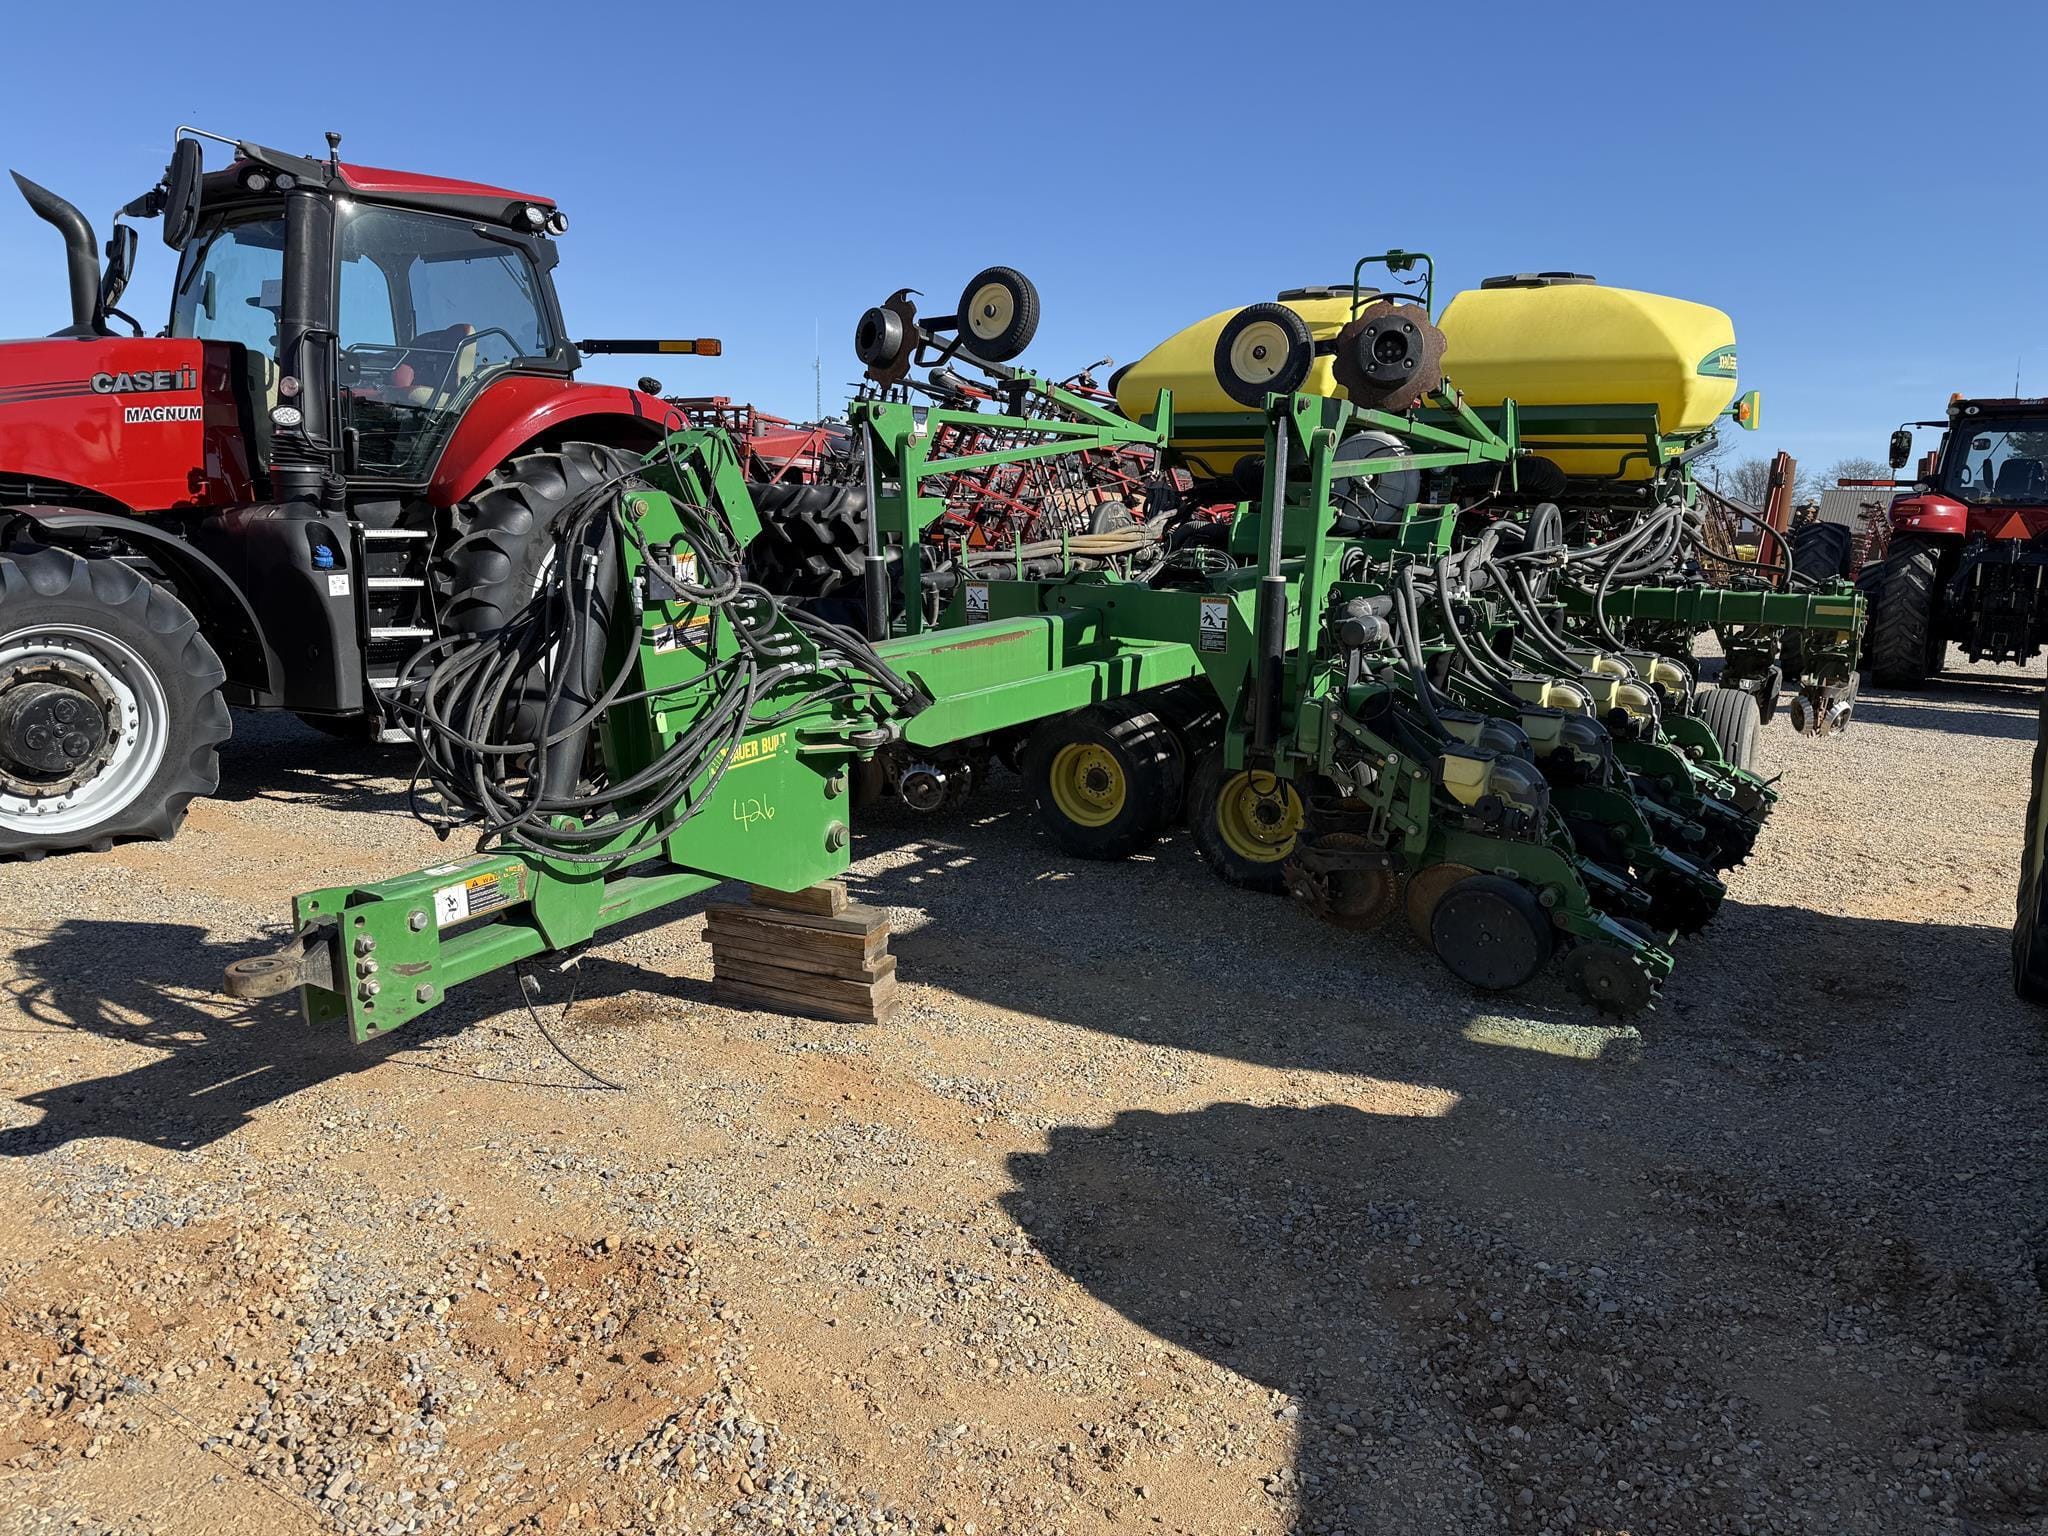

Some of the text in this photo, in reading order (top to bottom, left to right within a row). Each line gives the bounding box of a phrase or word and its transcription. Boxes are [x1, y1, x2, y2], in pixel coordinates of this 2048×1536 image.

[90, 371, 171, 394] CASE
[125, 405, 203, 424] MAGNUM
[731, 740, 759, 763] AUER
[733, 793, 775, 832] 426
